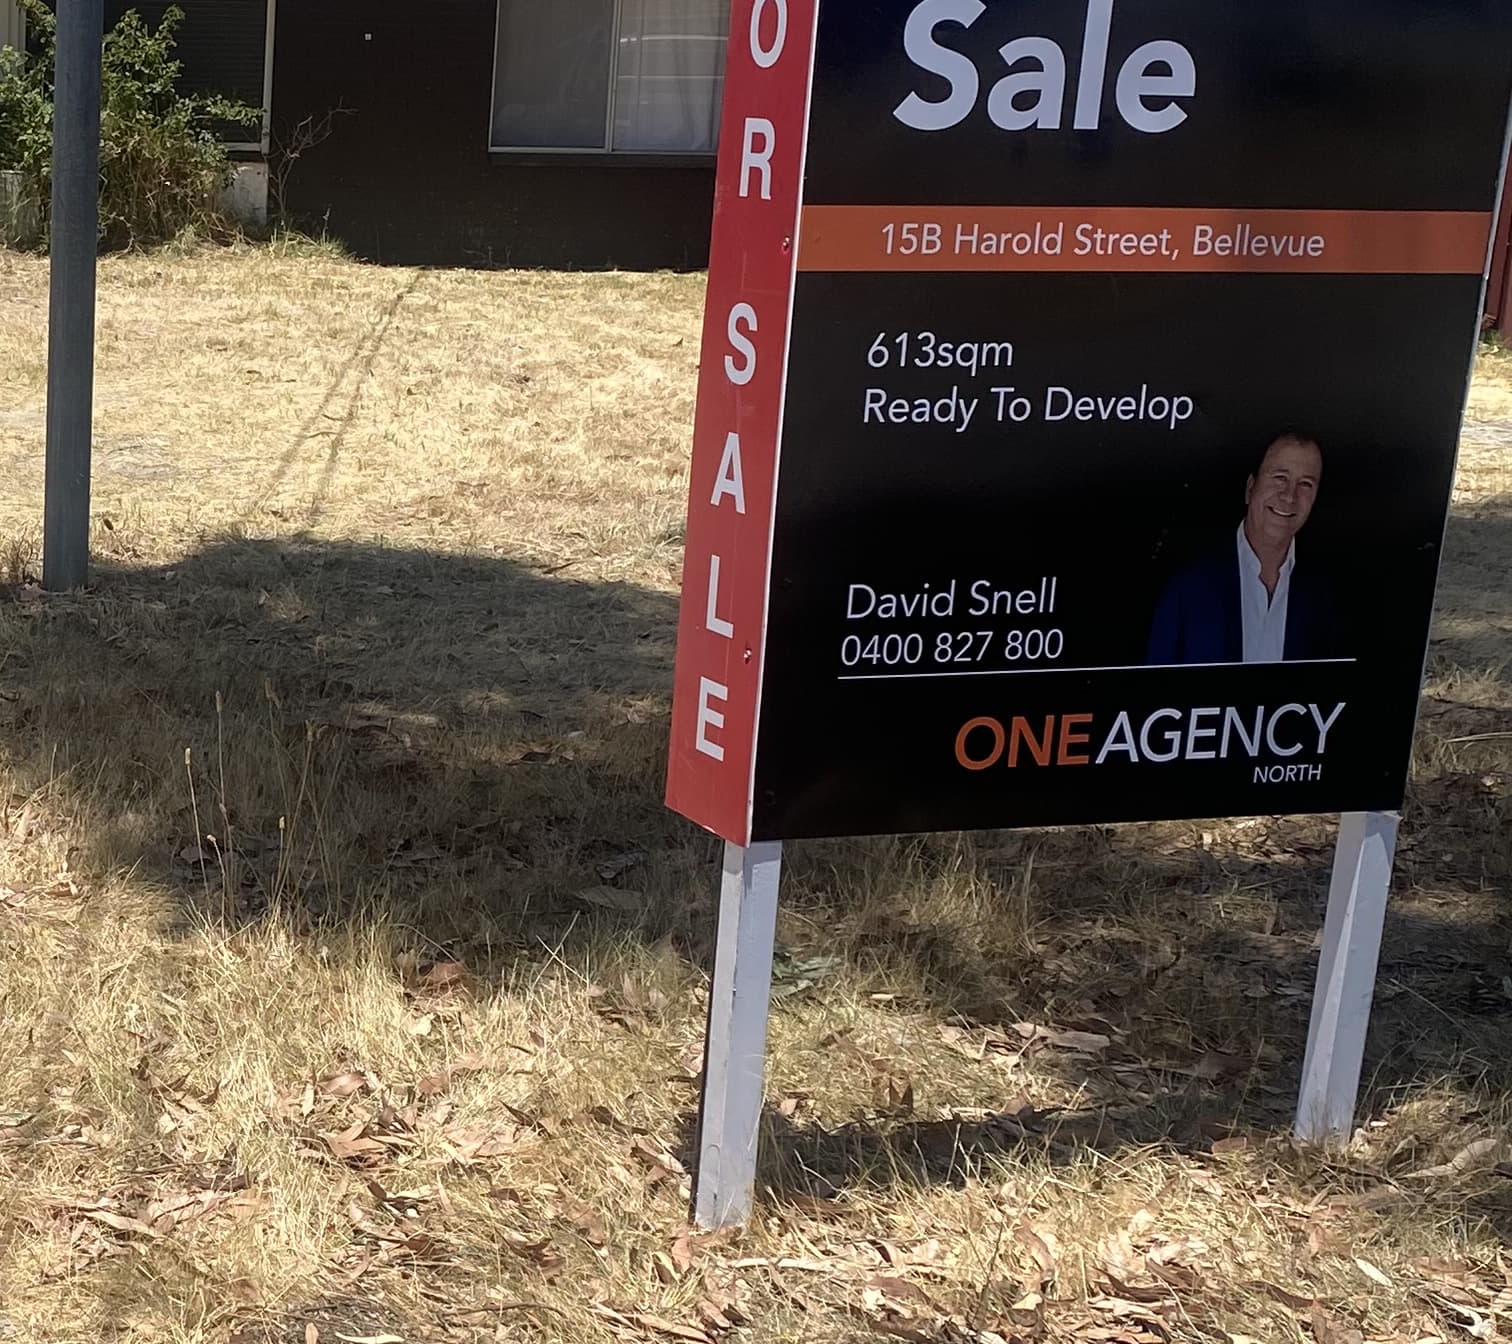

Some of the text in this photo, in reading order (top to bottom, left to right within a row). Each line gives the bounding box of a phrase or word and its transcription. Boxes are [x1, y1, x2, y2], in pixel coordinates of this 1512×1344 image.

[882, 222, 1325, 261] 15B Harold Street, Bellevue
[867, 331, 1013, 377] 613sqm
[863, 384, 1193, 433] Ready To Develop
[696, 303, 757, 761] SALE
[846, 576, 1057, 619] David Snell
[841, 628, 1064, 666] 0400 827 800
[1253, 764, 1322, 783] NORTH
